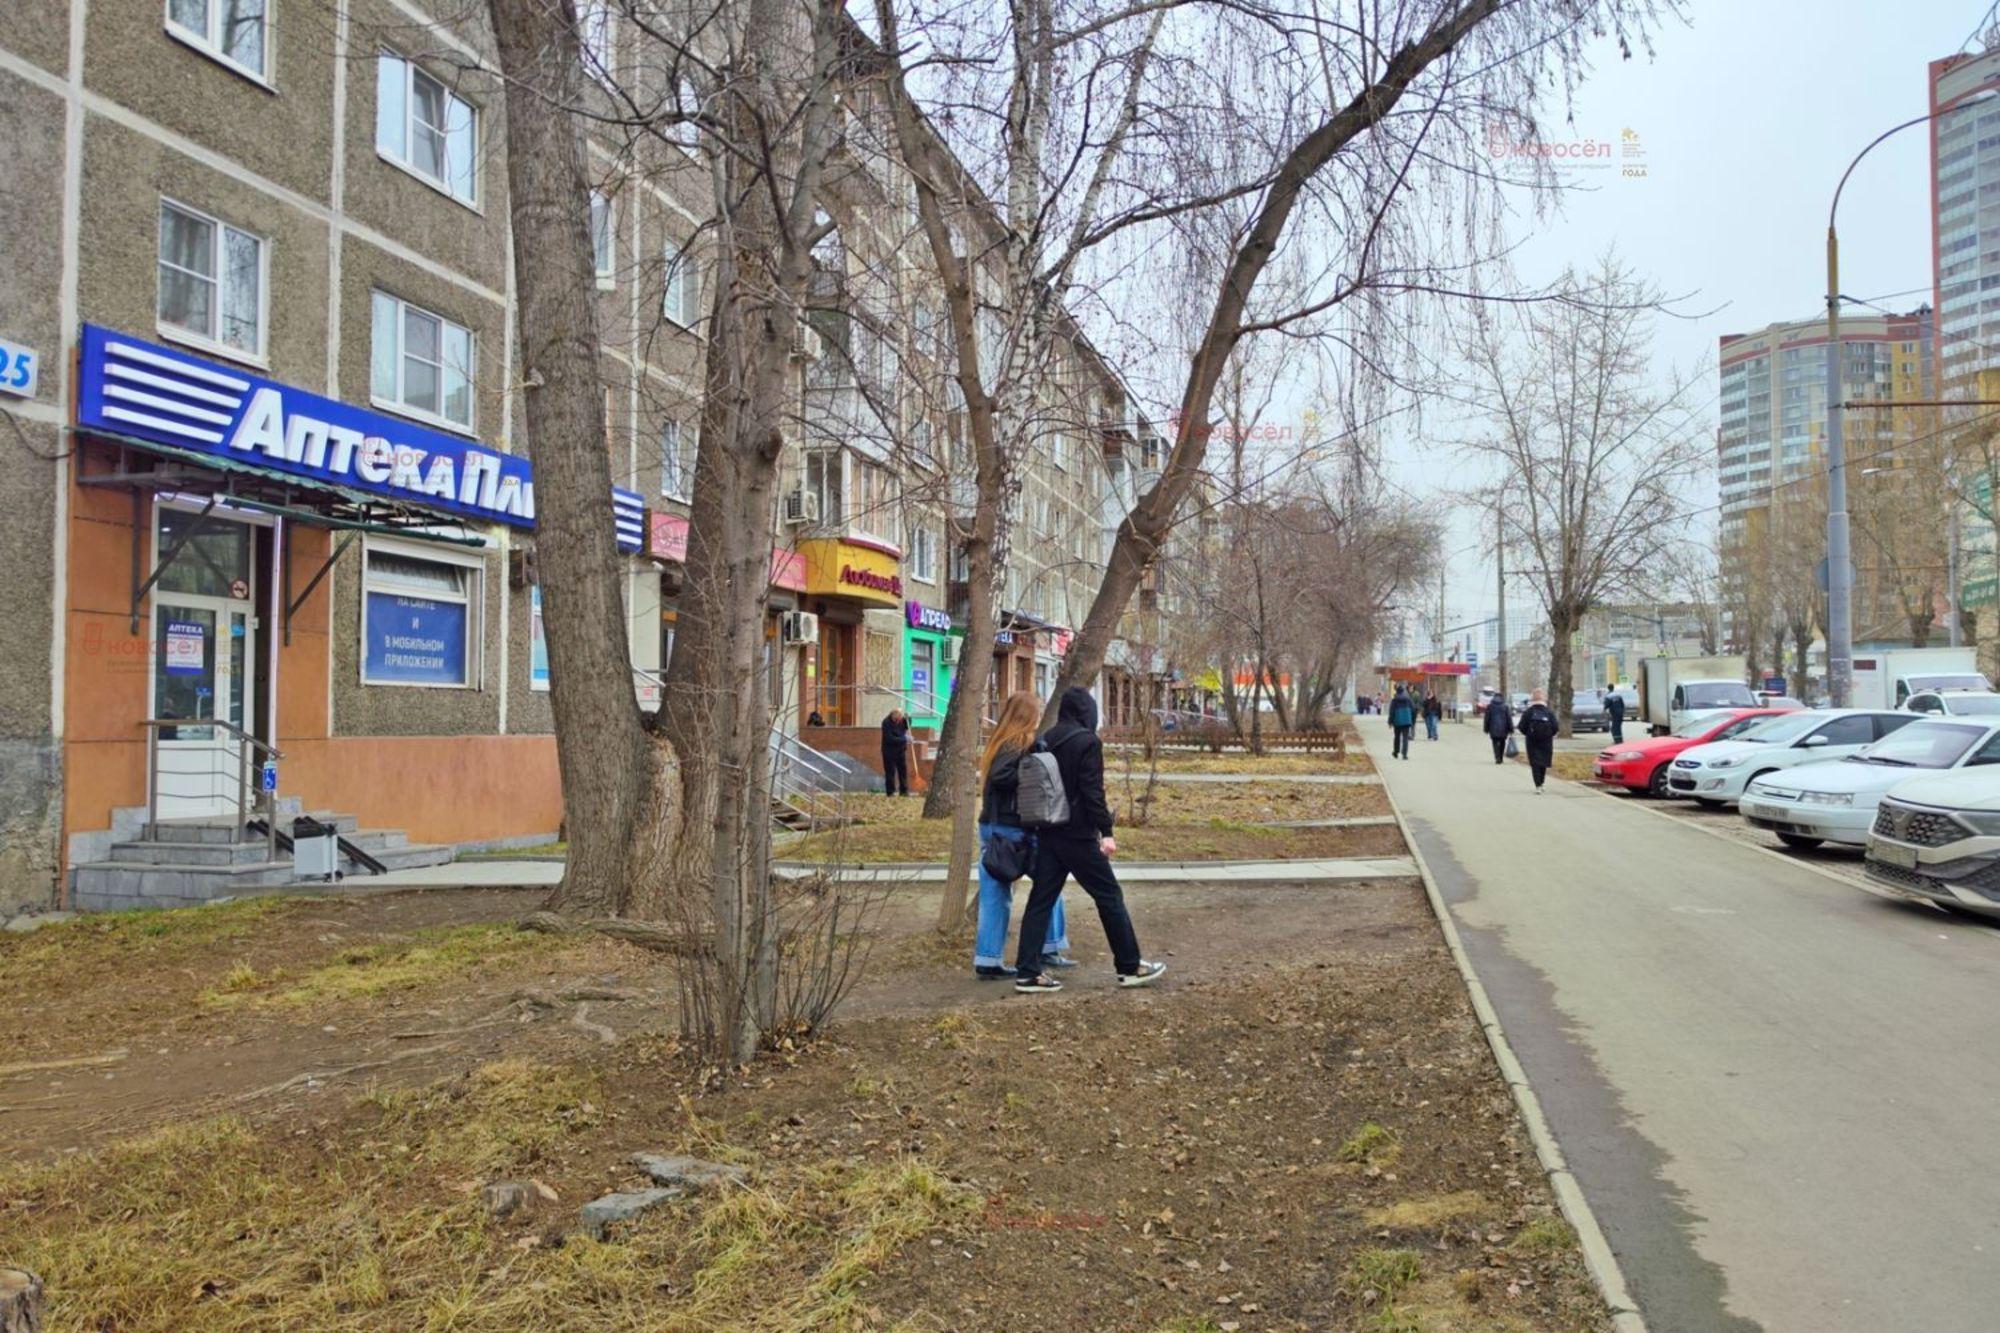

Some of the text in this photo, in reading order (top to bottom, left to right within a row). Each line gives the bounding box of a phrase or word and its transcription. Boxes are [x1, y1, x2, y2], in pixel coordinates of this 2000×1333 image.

[168, 623, 204, 634] АПТЕКА
[392, 636, 445, 652] МОБИЛЬНОМ
[384, 653, 445, 669] ПРИЛОЖЕНИИ
